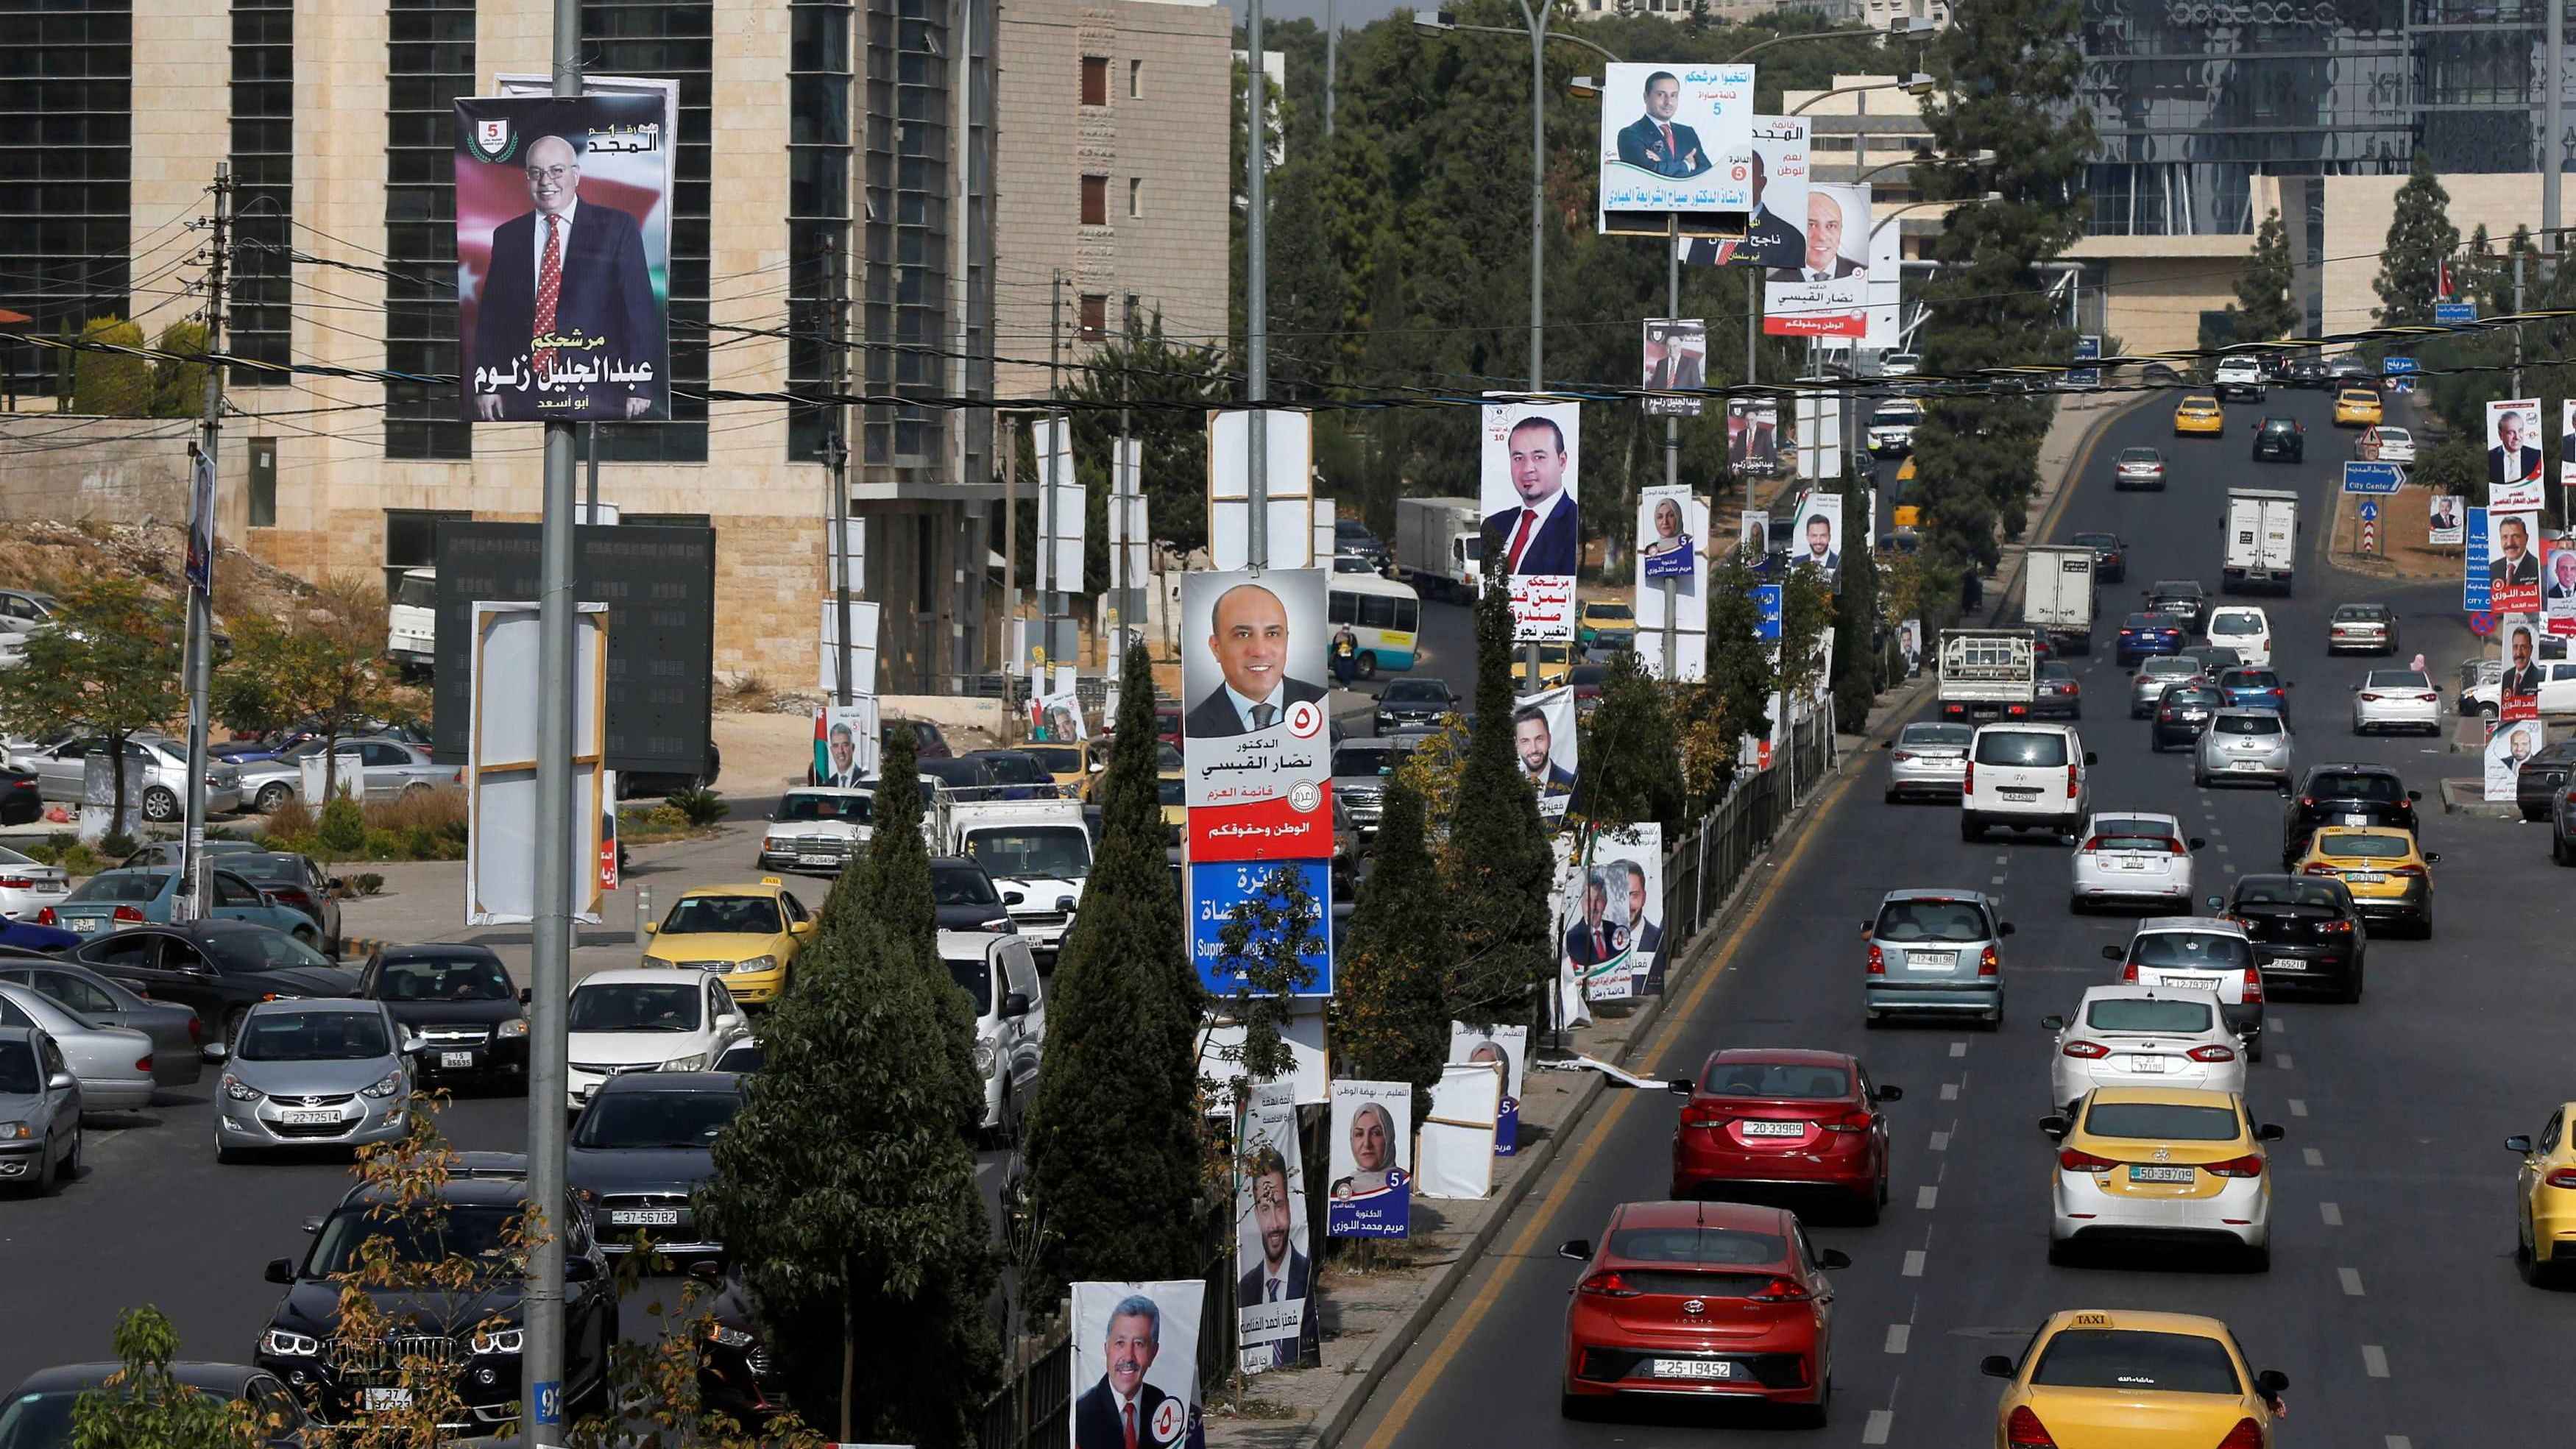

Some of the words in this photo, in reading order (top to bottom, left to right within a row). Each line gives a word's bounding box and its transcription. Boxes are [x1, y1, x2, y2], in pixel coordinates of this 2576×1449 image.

[1713, 102, 1721, 115] 5
[488, 124, 498, 138] 5
[588, 132, 657, 157] المجد
[531, 328, 606, 352] مرشحكم
[474, 354, 531, 394] زلوم
[537, 395, 571, 408] أسعد
[575, 395, 589, 410] أبو
[1526, 575, 1569, 589] مرشحكم
[1532, 588, 1571, 607] أيمن
[1520, 625, 1538, 640] نحو
[1540, 625, 1571, 640] التغيير
[1294, 707, 1310, 729] ٥
[1236, 739, 1278, 752] الدكتور
[1201, 755, 1267, 780] القيسي
[1207, 787, 1236, 801] العزم
[1241, 784, 1273, 796] قائمة
[1209, 823, 1270, 839] وحقوقكم
[1273, 822, 1310, 837] الوطن
[1197, 938, 1238, 960] Supre
[1337, 1086, 1359, 1096] الوطن
[1385, 1088, 1409, 1099] التعليم
[1501, 1101, 1510, 1113] 5
[293, 1113, 339, 1123] 22-72514
[1390, 1172, 1399, 1186] 5
[623, 1211, 676, 1224] 37-56782
[1355, 1209, 1382, 1219] الدكتورة
[1332, 1220, 1359, 1234] اللوزي
[1384, 1224, 1404, 1235] مريم
[2076, 1314, 2106, 1325] TAXI
[1666, 1361, 1728, 1376] 25-19452
